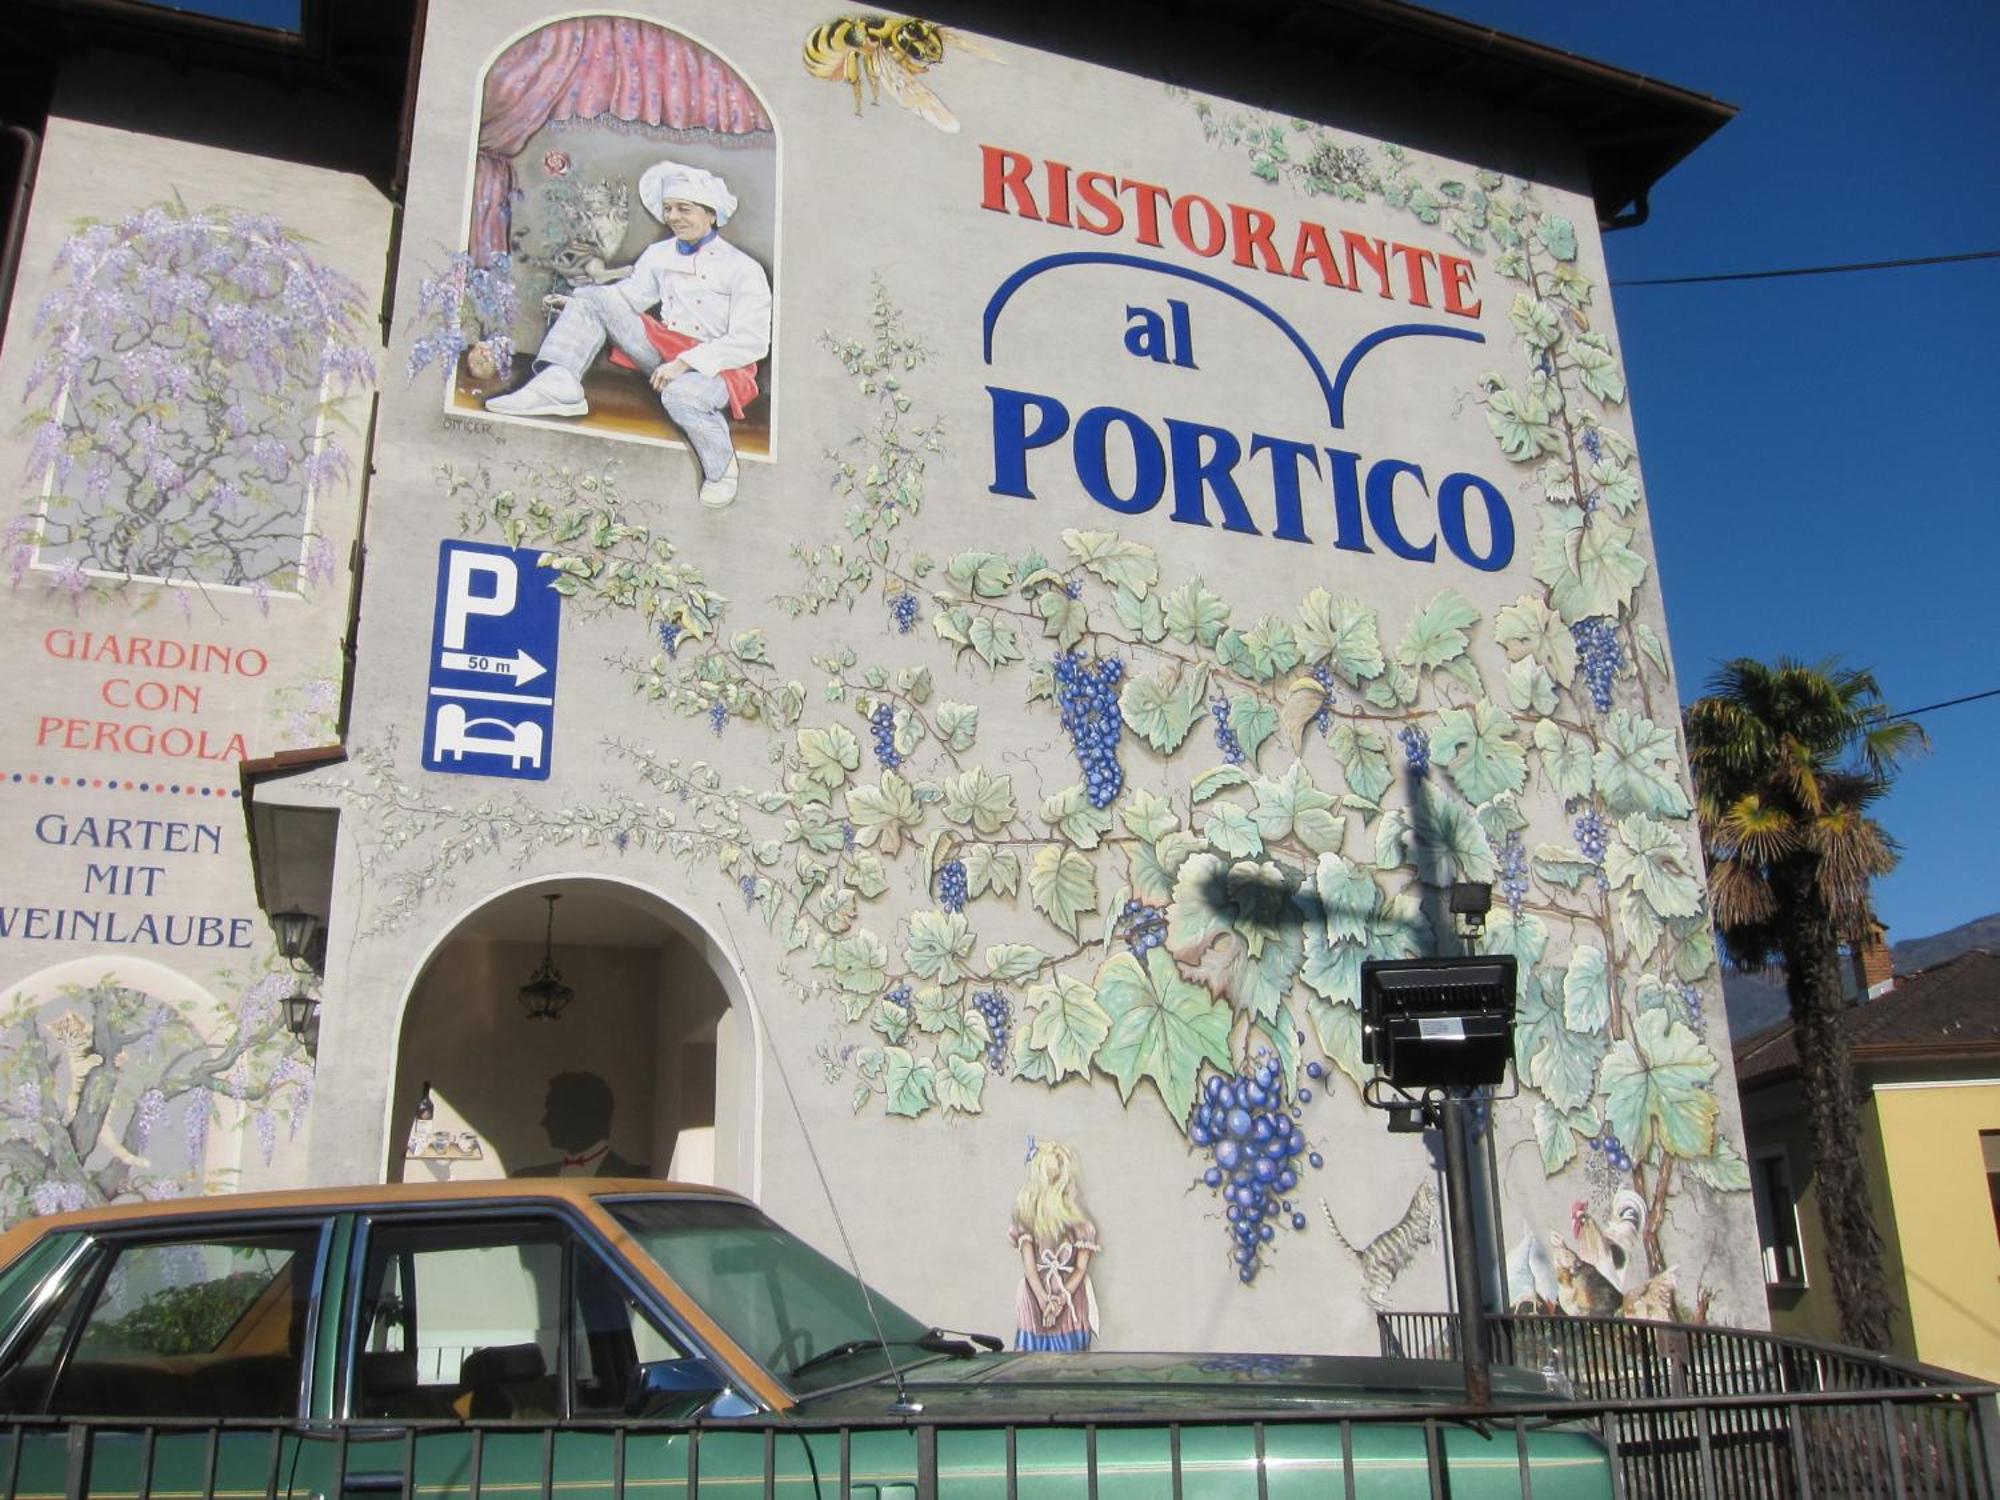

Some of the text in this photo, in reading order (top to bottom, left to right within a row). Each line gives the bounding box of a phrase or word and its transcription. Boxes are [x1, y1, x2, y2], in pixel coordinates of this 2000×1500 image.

[979, 144, 1482, 319] RISTORANTE
[1124, 298, 1200, 370] al
[985, 385, 1515, 572] PORTICO
[443, 549, 518, 650] P
[44, 629, 268, 677] GIARDINO
[468, 656, 511, 673] 50 m
[102, 678, 201, 714] CON
[36, 716, 250, 761] PERGOLA
[35, 814, 223, 854] GARTEN
[84, 863, 166, 896] MIT
